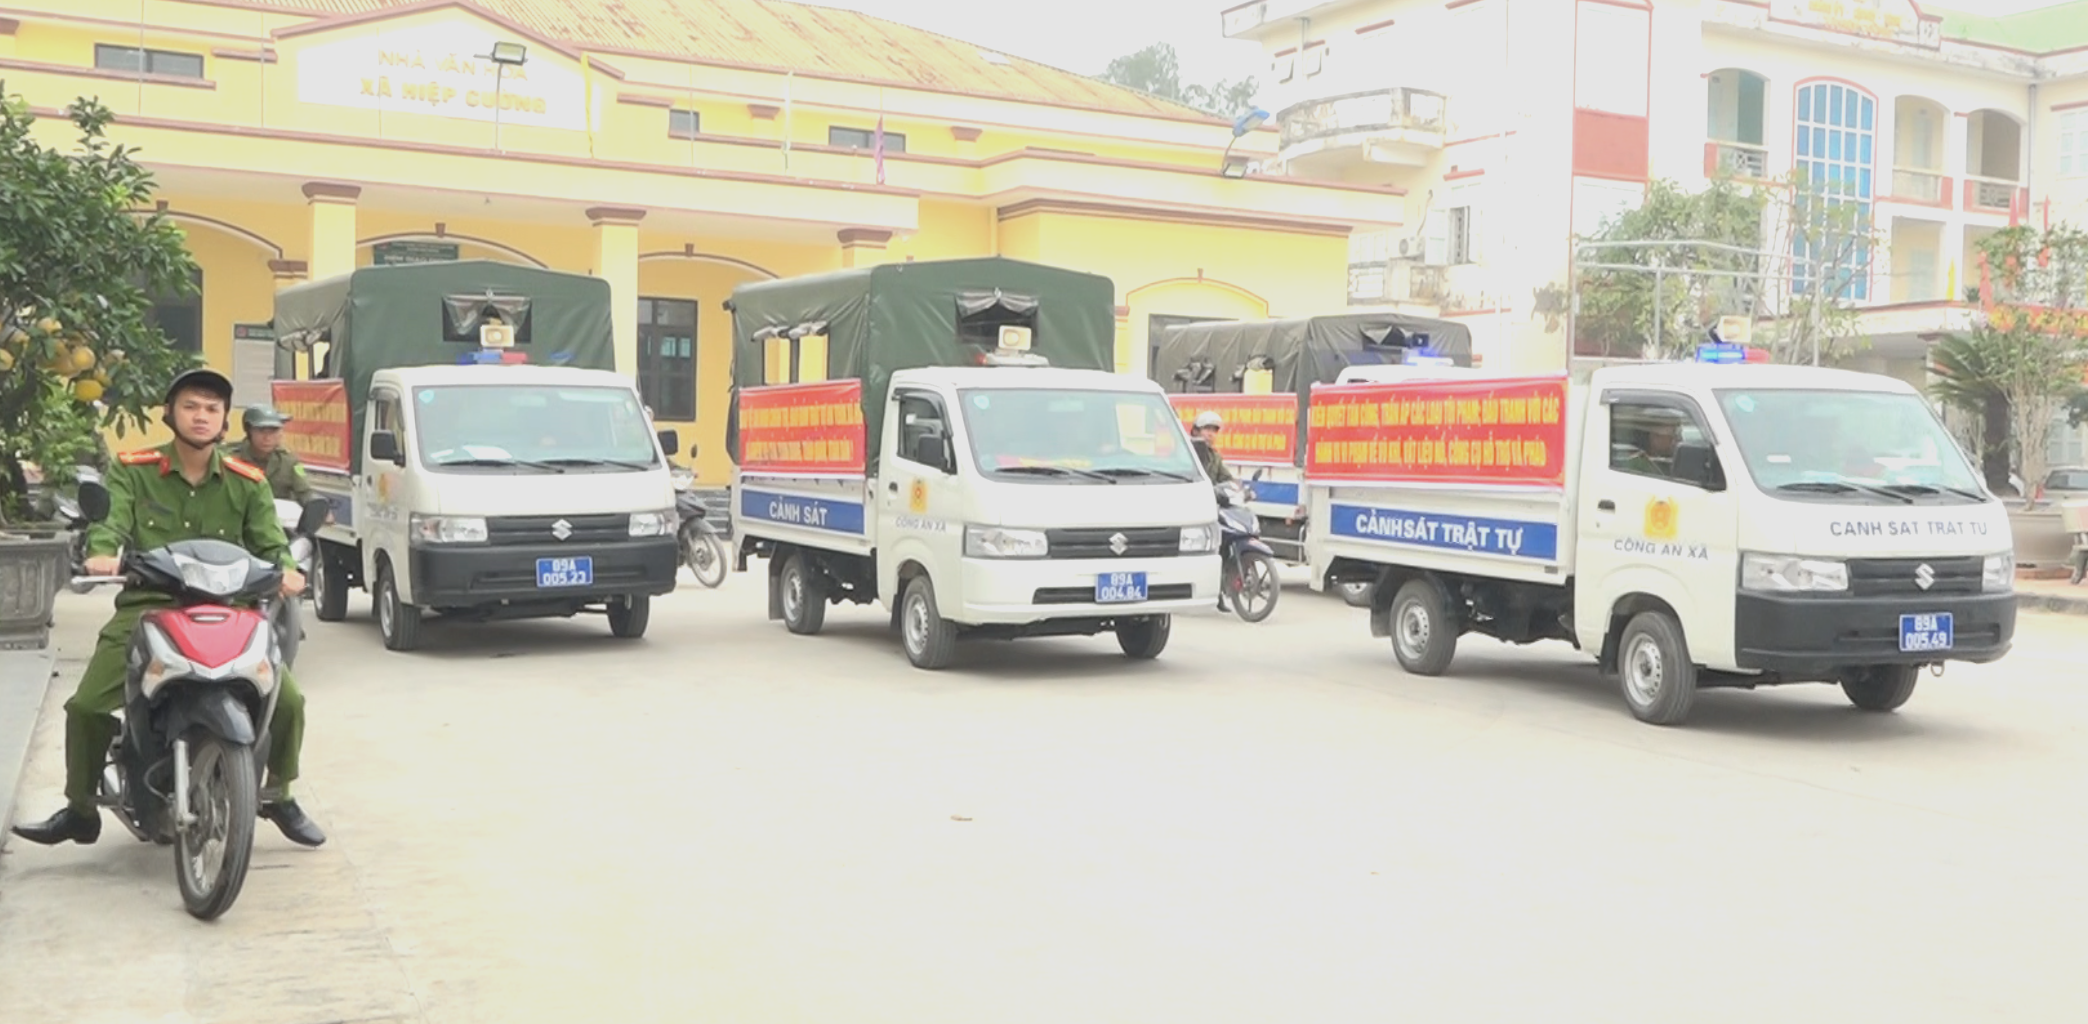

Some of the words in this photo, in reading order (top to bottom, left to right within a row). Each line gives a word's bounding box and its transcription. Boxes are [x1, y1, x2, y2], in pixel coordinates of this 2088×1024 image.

[378, 48, 426, 70] NHÀ
[434, 53, 475, 76] VĂN
[401, 81, 458, 107] HIỆP
[1543, 390, 1560, 424] CÁC
[769, 495, 800, 522] CẢNH
[803, 501, 828, 526] SÁT
[1441, 520, 1490, 551] TRẬT
[1495, 527, 1524, 555] TỰ
[1614, 536, 1656, 554] CÔNG
[1660, 543, 1683, 556] AN
[1687, 542, 1708, 561] XÃ
[543, 571, 586, 586] 005.23
[1111, 573, 1133, 586] 89A
[1101, 586, 1142, 601] 004.84
[1914, 615, 1938, 631] 89A
[1905, 631, 1947, 649] 005.49
